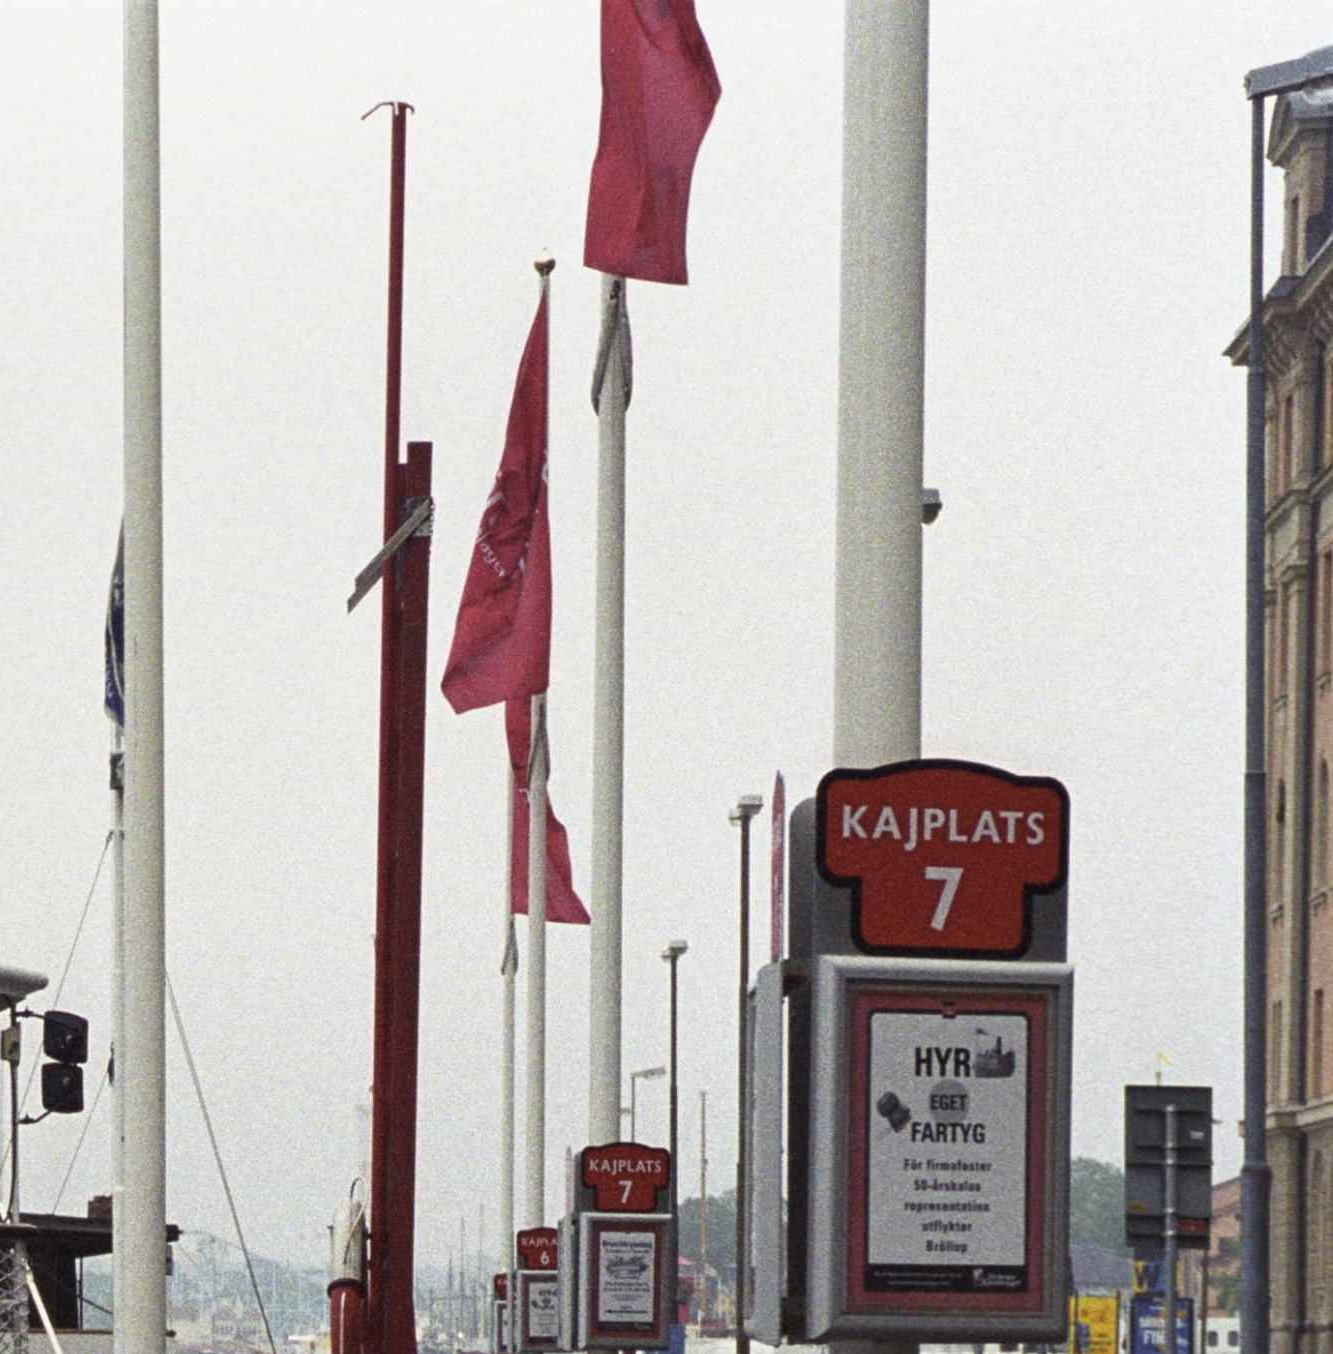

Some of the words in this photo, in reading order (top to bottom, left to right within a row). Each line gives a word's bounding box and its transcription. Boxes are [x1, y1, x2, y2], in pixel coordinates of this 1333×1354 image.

[842, 805, 1045, 851] KAJPLATS
[925, 866, 964, 931] 7
[914, 1047, 971, 1077] HYR
[930, 1094, 968, 1111] EGET
[910, 1122, 986, 1144] FARTYG
[589, 1159, 662, 1176] KAJPLATS
[903, 1158, 923, 1171] För
[926, 1159, 992, 1172] firmafester
[619, 1180, 633, 1204] 7
[913, 1178, 982, 1192] 50-årskalas
[904, 1201, 991, 1213] representation
[921, 1219, 973, 1234] utflykter
[521, 1237, 559, 1248] KAJPLA
[925, 1240, 969, 1254] Bröllop
[540, 1250, 550, 1265] 6
